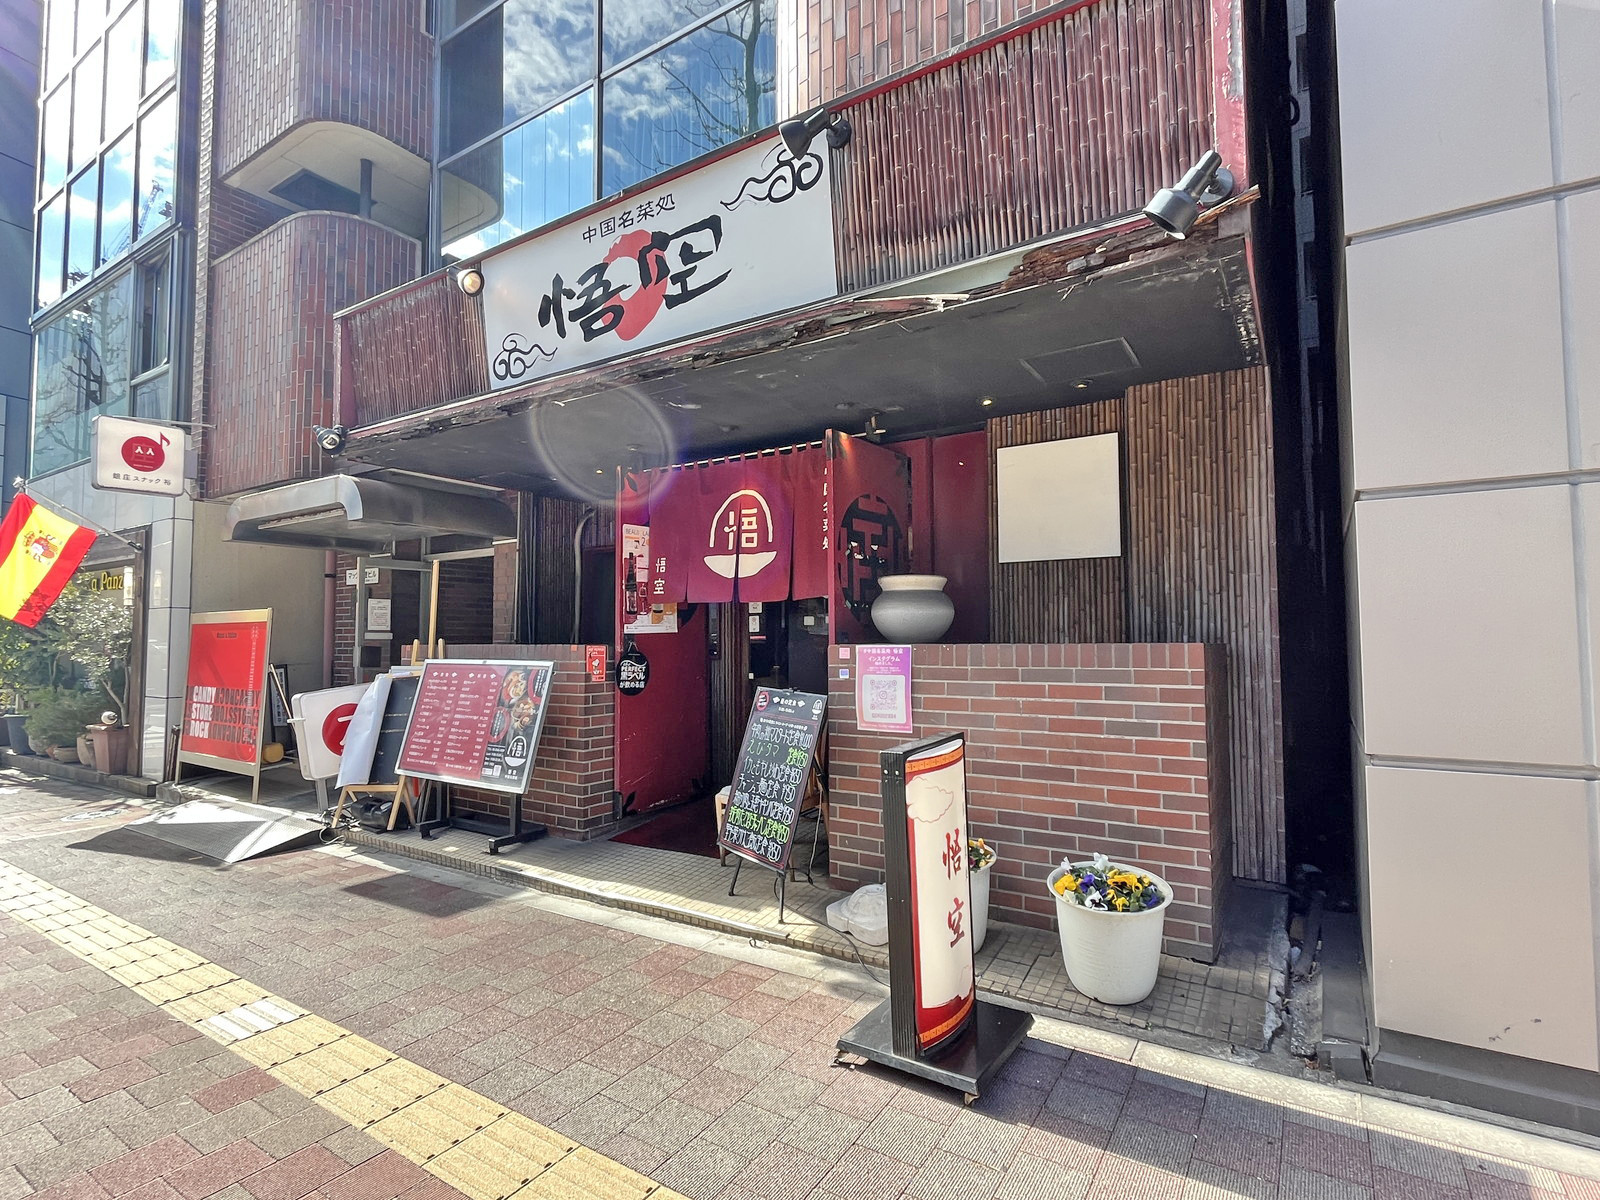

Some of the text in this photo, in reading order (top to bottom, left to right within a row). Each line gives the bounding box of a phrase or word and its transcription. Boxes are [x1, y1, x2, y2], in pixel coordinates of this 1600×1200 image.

[582, 193, 677, 244] 中国名菜処
[537, 214, 733, 343] 悟空
[723, 508, 758, 551] 悟
[100, 571, 123, 591] Panz
[653, 557, 667, 595] 悟空
[619, 681, 645, 689] が飲める店
[620, 672, 645, 680] 黒ラベル
[192, 685, 217, 704] CANDY
[191, 702, 214, 721] STORE
[189, 720, 210, 739] ROCK
[942, 827, 965, 948] 悟空
